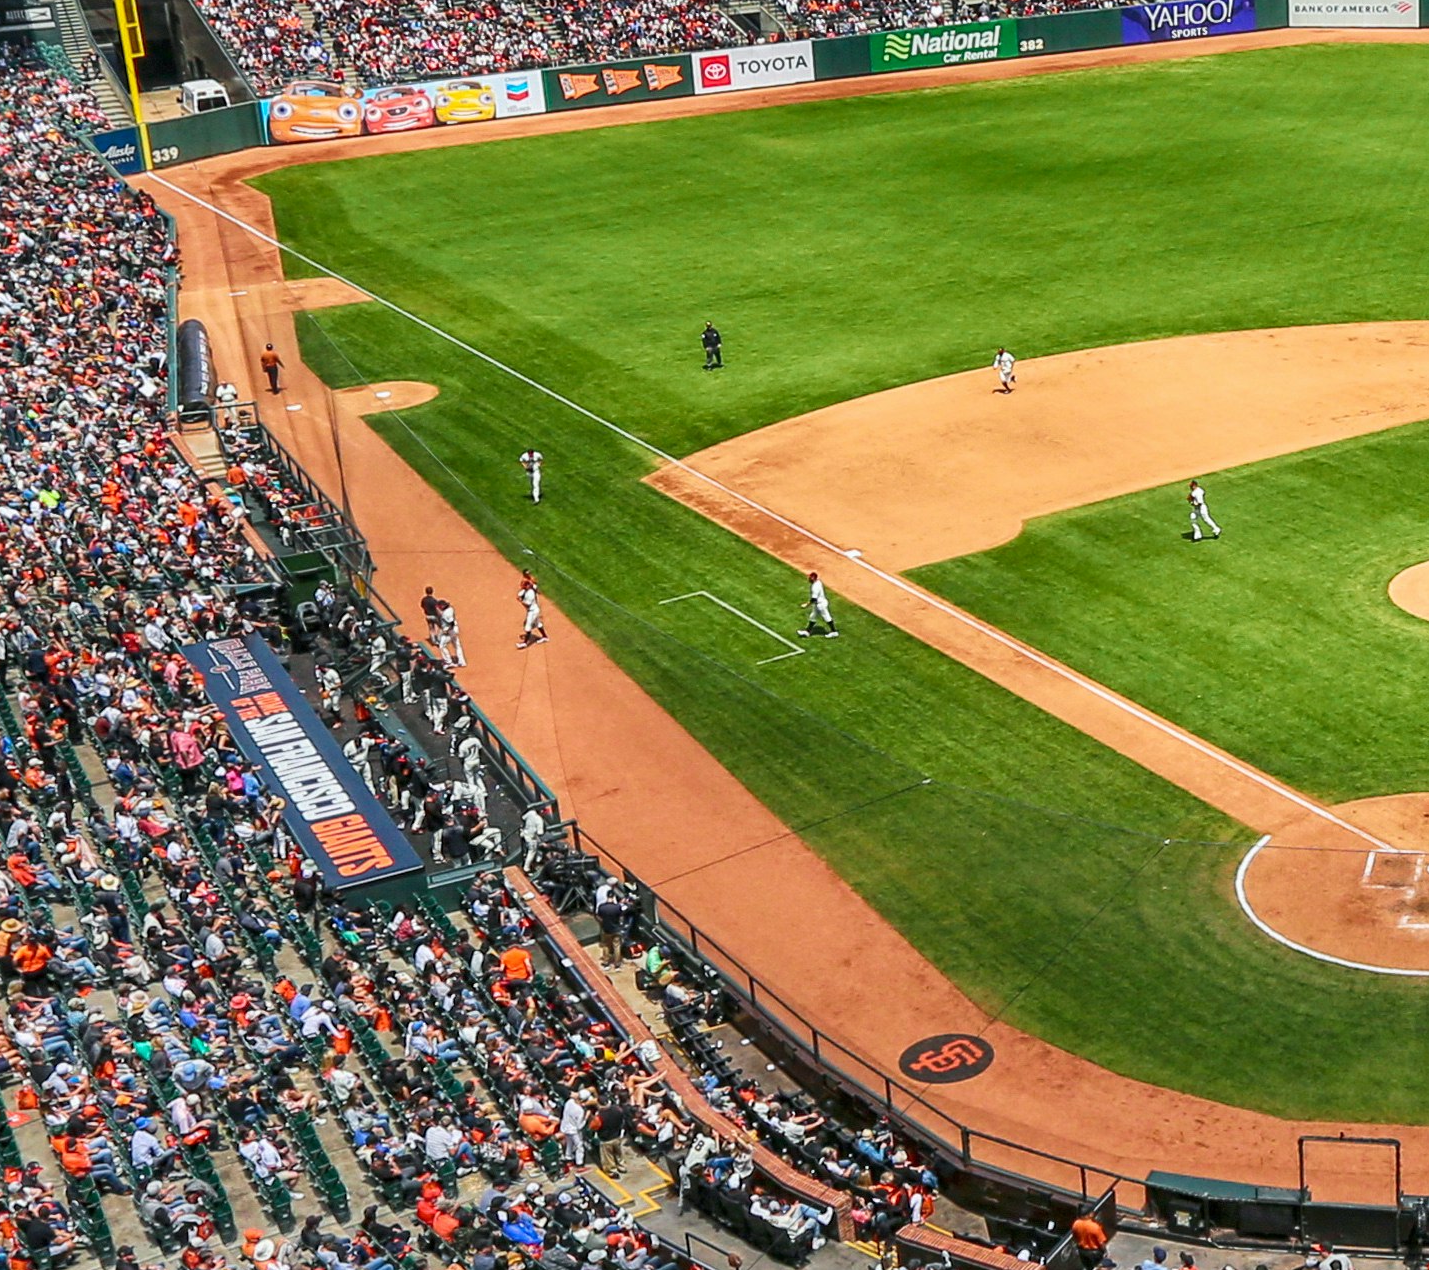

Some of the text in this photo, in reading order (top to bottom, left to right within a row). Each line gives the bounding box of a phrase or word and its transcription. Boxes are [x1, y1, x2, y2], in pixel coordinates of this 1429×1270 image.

[1294, 4, 1389, 14] BANK OF AMERICA
[911, 25, 1001, 58] National
[1171, 27, 1208, 39] SPORTS
[1019, 38, 1044, 52] 382
[943, 47, 998, 64] Car Rental
[738, 55, 808, 75] TOYOTA
[152, 146, 179, 163] 339
[209, 638, 273, 695] ORACLE PARK
[243, 711, 356, 822] SAN FRANCISCO
[309, 814, 395, 878] GIANTS
